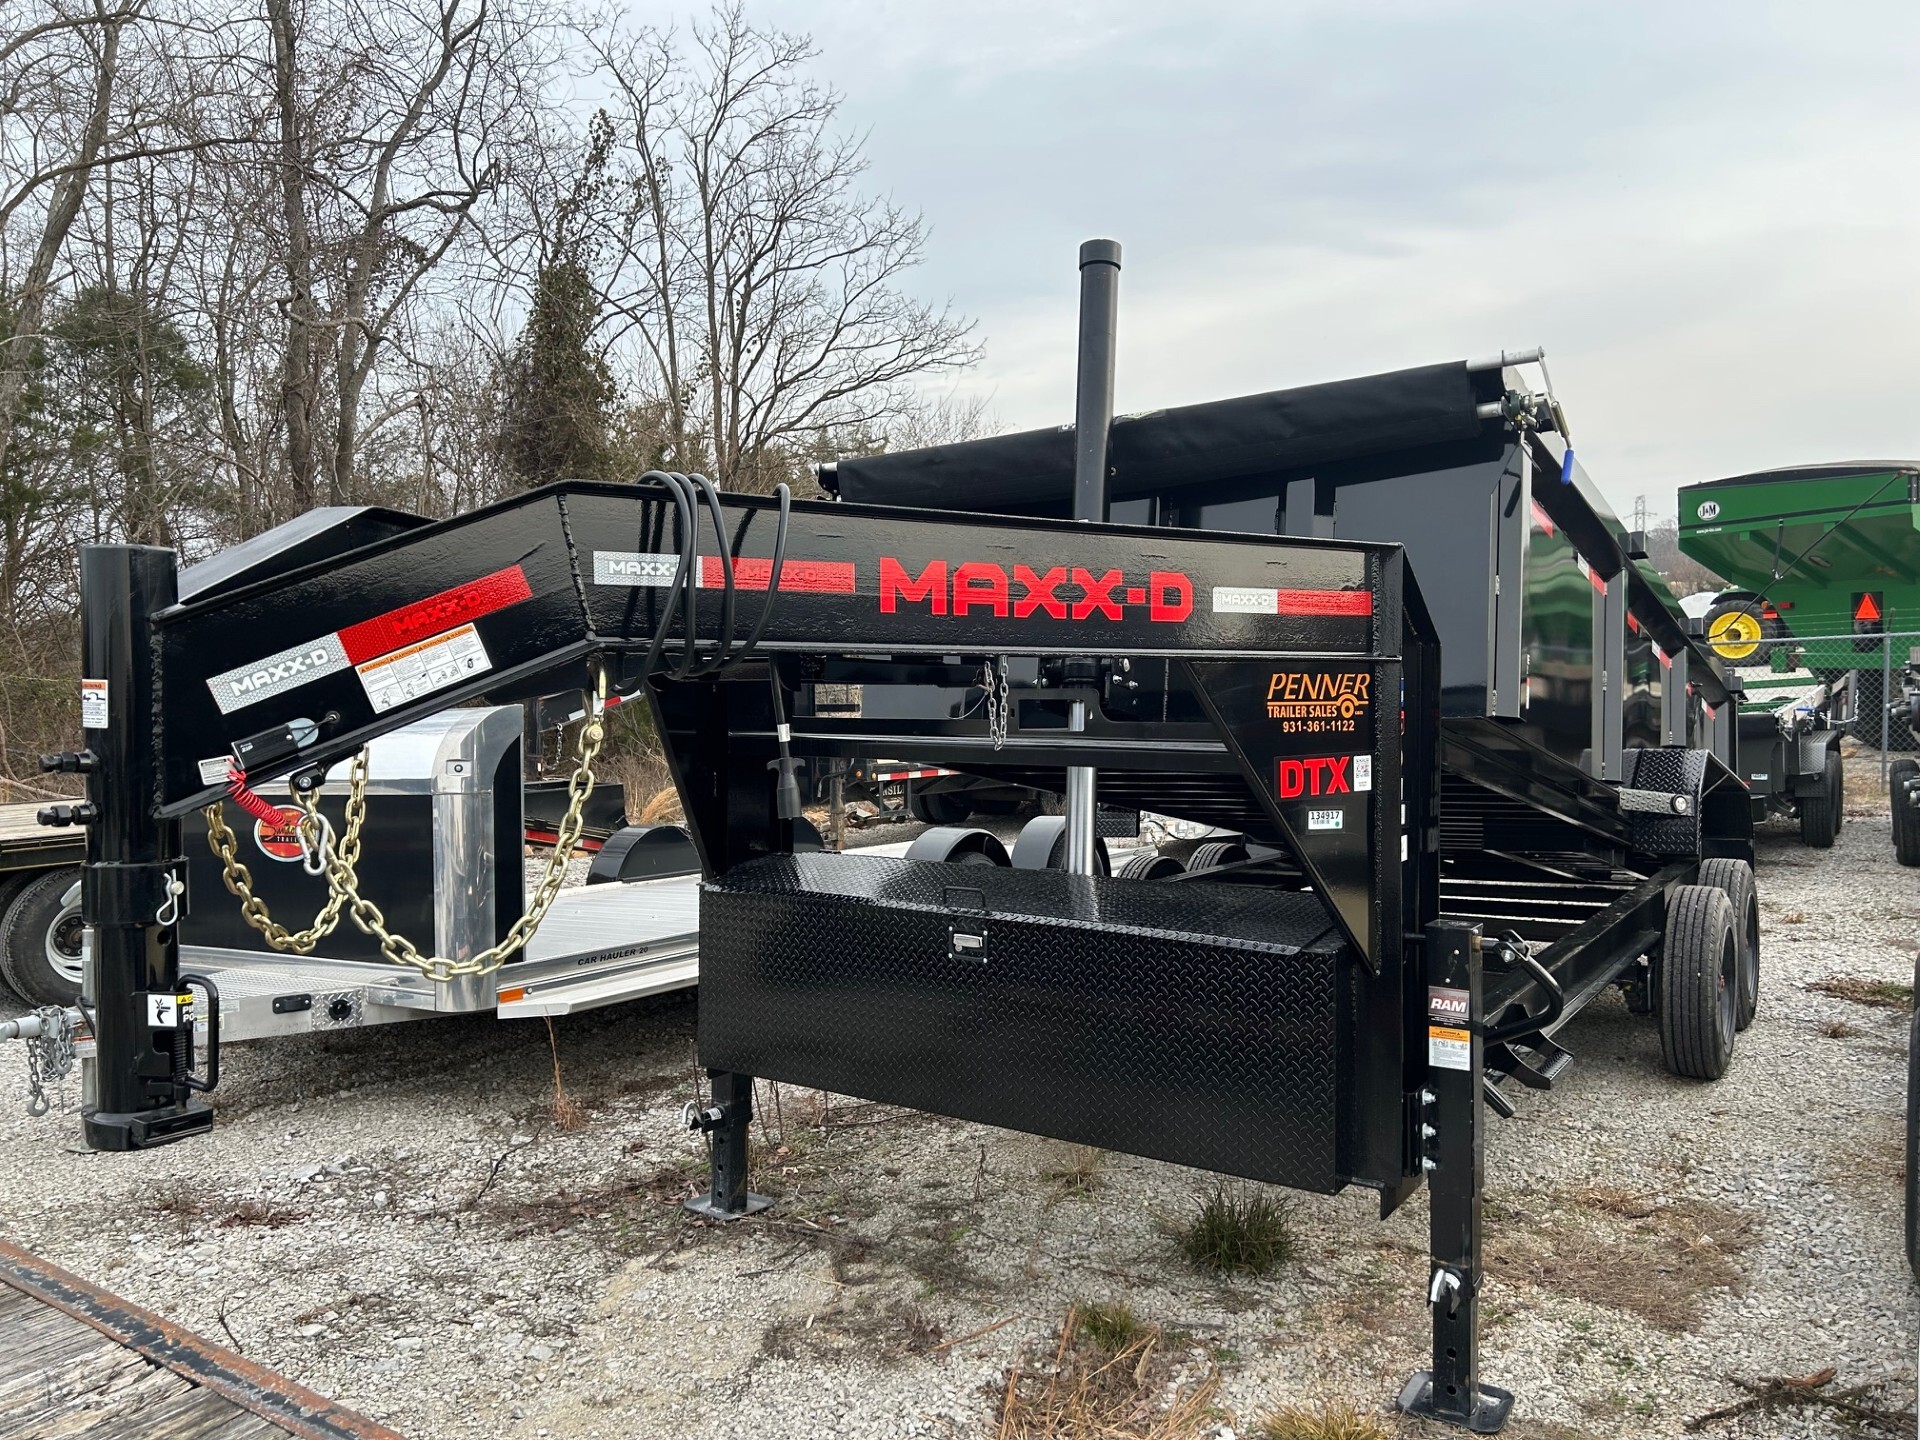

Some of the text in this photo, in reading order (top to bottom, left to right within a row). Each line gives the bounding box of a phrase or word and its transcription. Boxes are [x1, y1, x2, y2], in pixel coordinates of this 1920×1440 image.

[879, 557, 1194, 622] MAXX-D
[1221, 593, 1270, 606] MAXX-D
[392, 590, 481, 634] MAXX-D
[229, 649, 329, 697] MAXX-D
[1267, 673, 1371, 700] PENNER
[1267, 705, 1307, 718] TRAILER
[1309, 705, 1337, 717] SALES
[1283, 720, 1355, 732] 931-361-1122
[1280, 756, 1350, 798] DTX
[1311, 811, 1340, 820] 134917
[577, 946, 649, 966] CAR HAULER 20
[1430, 998, 1467, 1012] RAM
